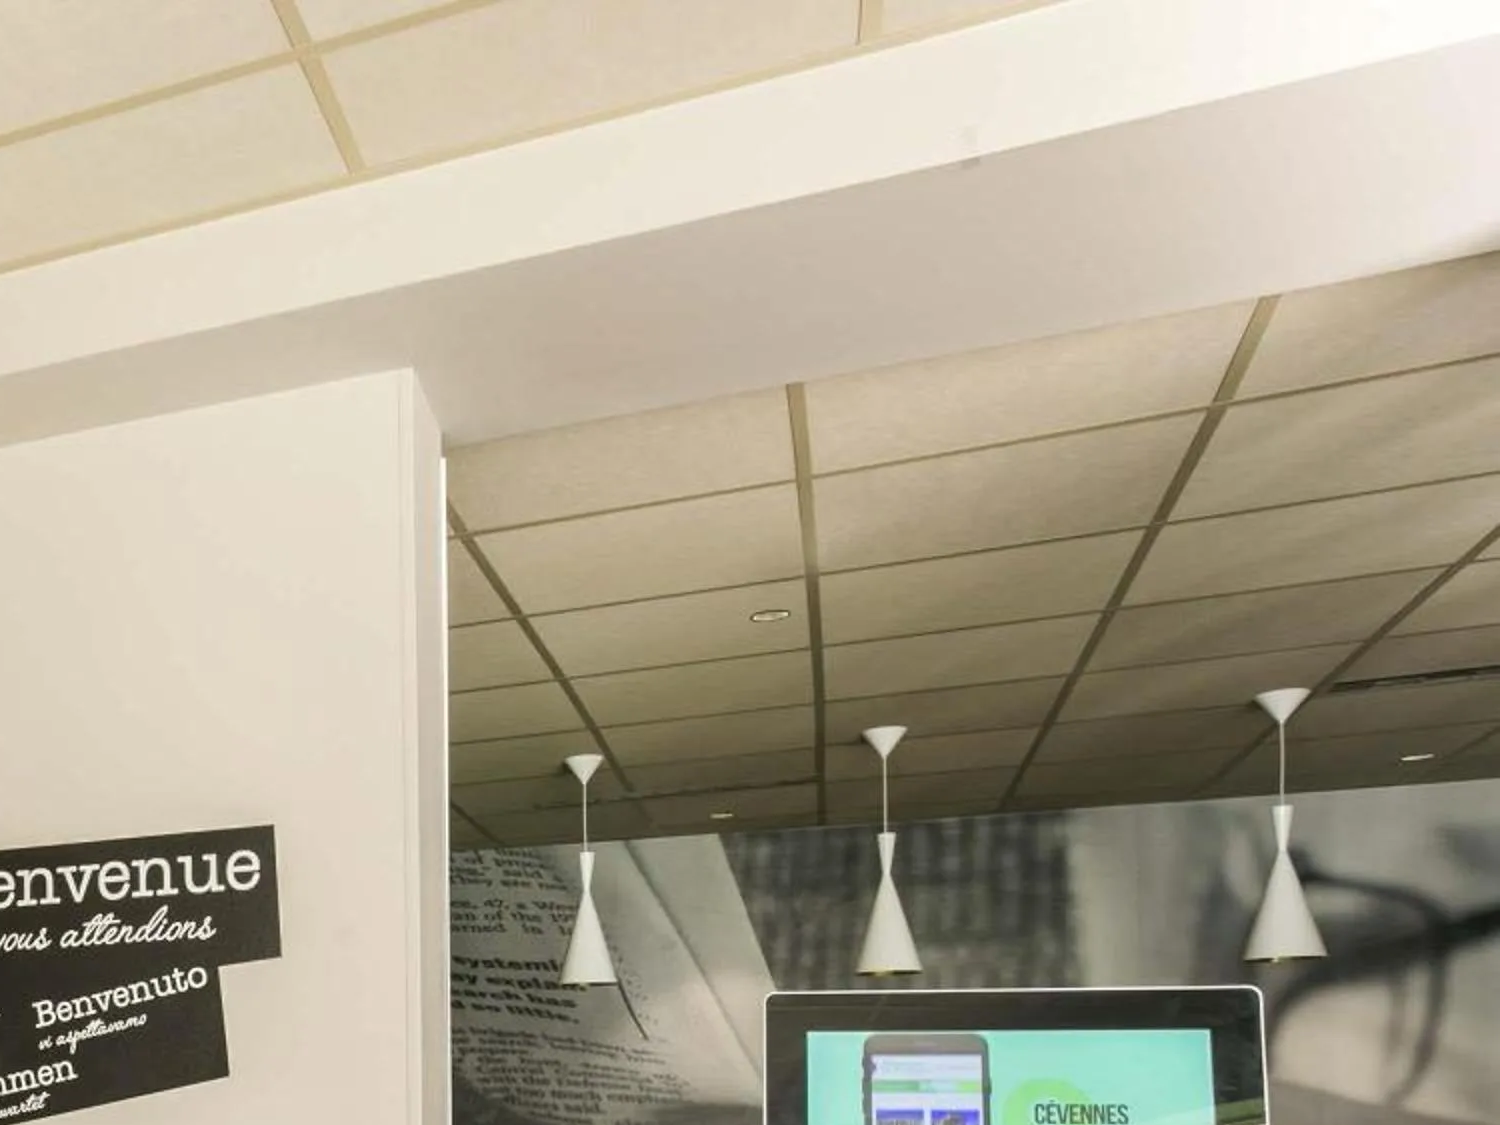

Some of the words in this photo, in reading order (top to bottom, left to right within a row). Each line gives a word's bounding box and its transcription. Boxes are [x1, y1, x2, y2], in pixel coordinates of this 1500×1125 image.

[60, 905, 217, 948] attendions
[32, 967, 208, 1028] Benvenuto
[56, 1013, 148, 1055] aspettavamo
[1034, 1099, 1129, 1125] CÉVENNES
